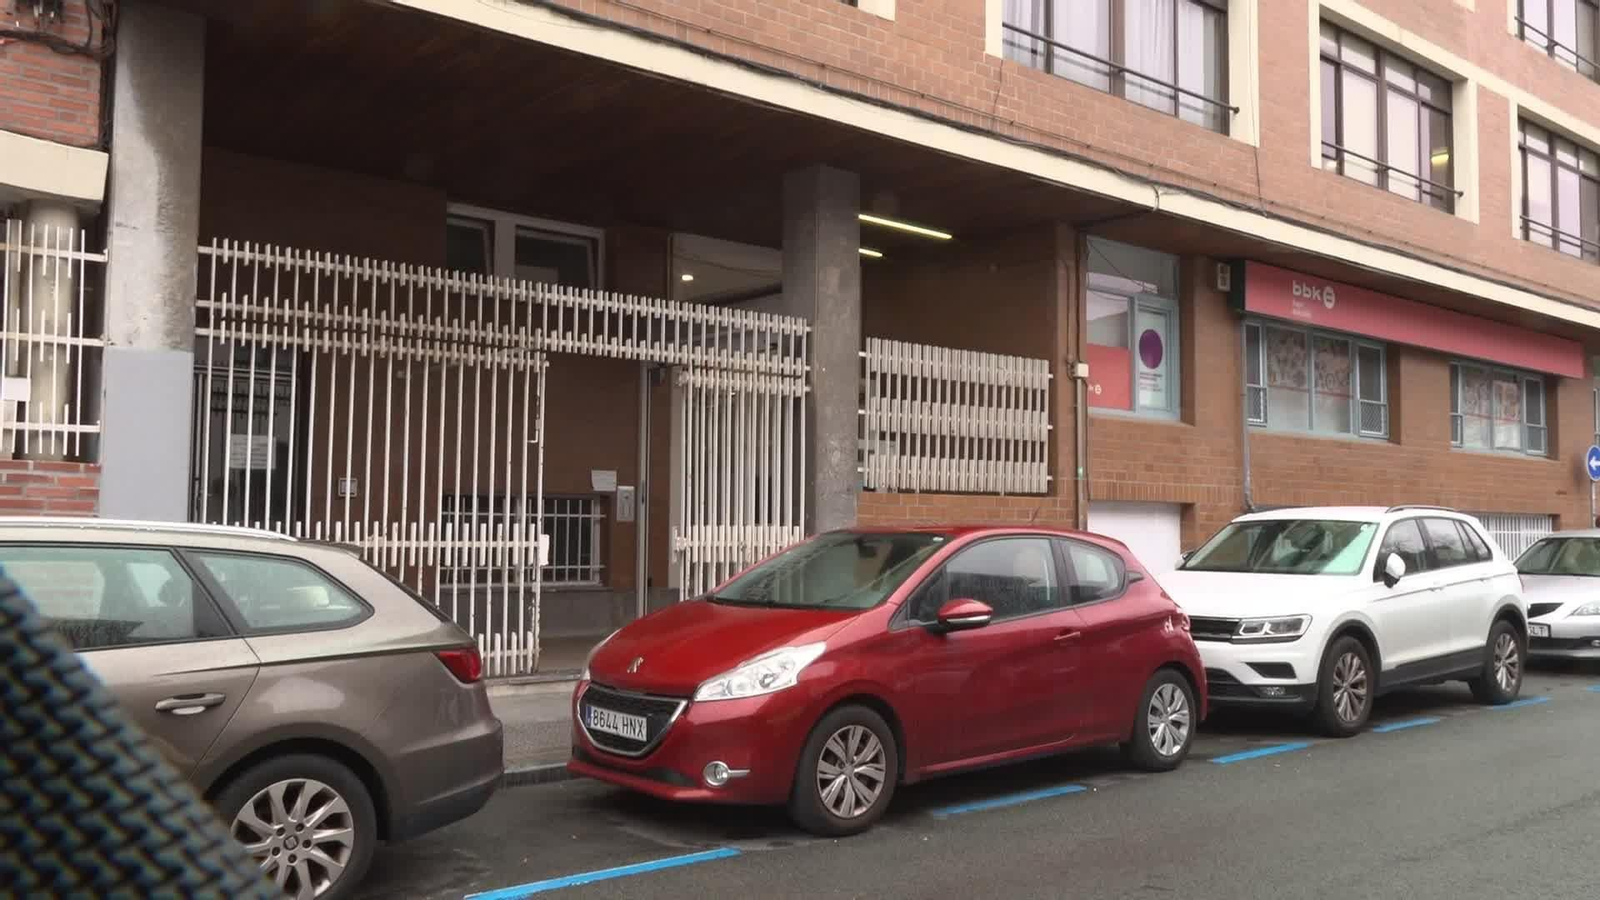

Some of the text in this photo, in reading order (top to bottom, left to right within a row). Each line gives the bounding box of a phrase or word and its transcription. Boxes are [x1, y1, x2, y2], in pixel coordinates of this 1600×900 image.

[1293, 280, 1321, 301] bbk
[593, 709, 644, 740] 8644 HNX
